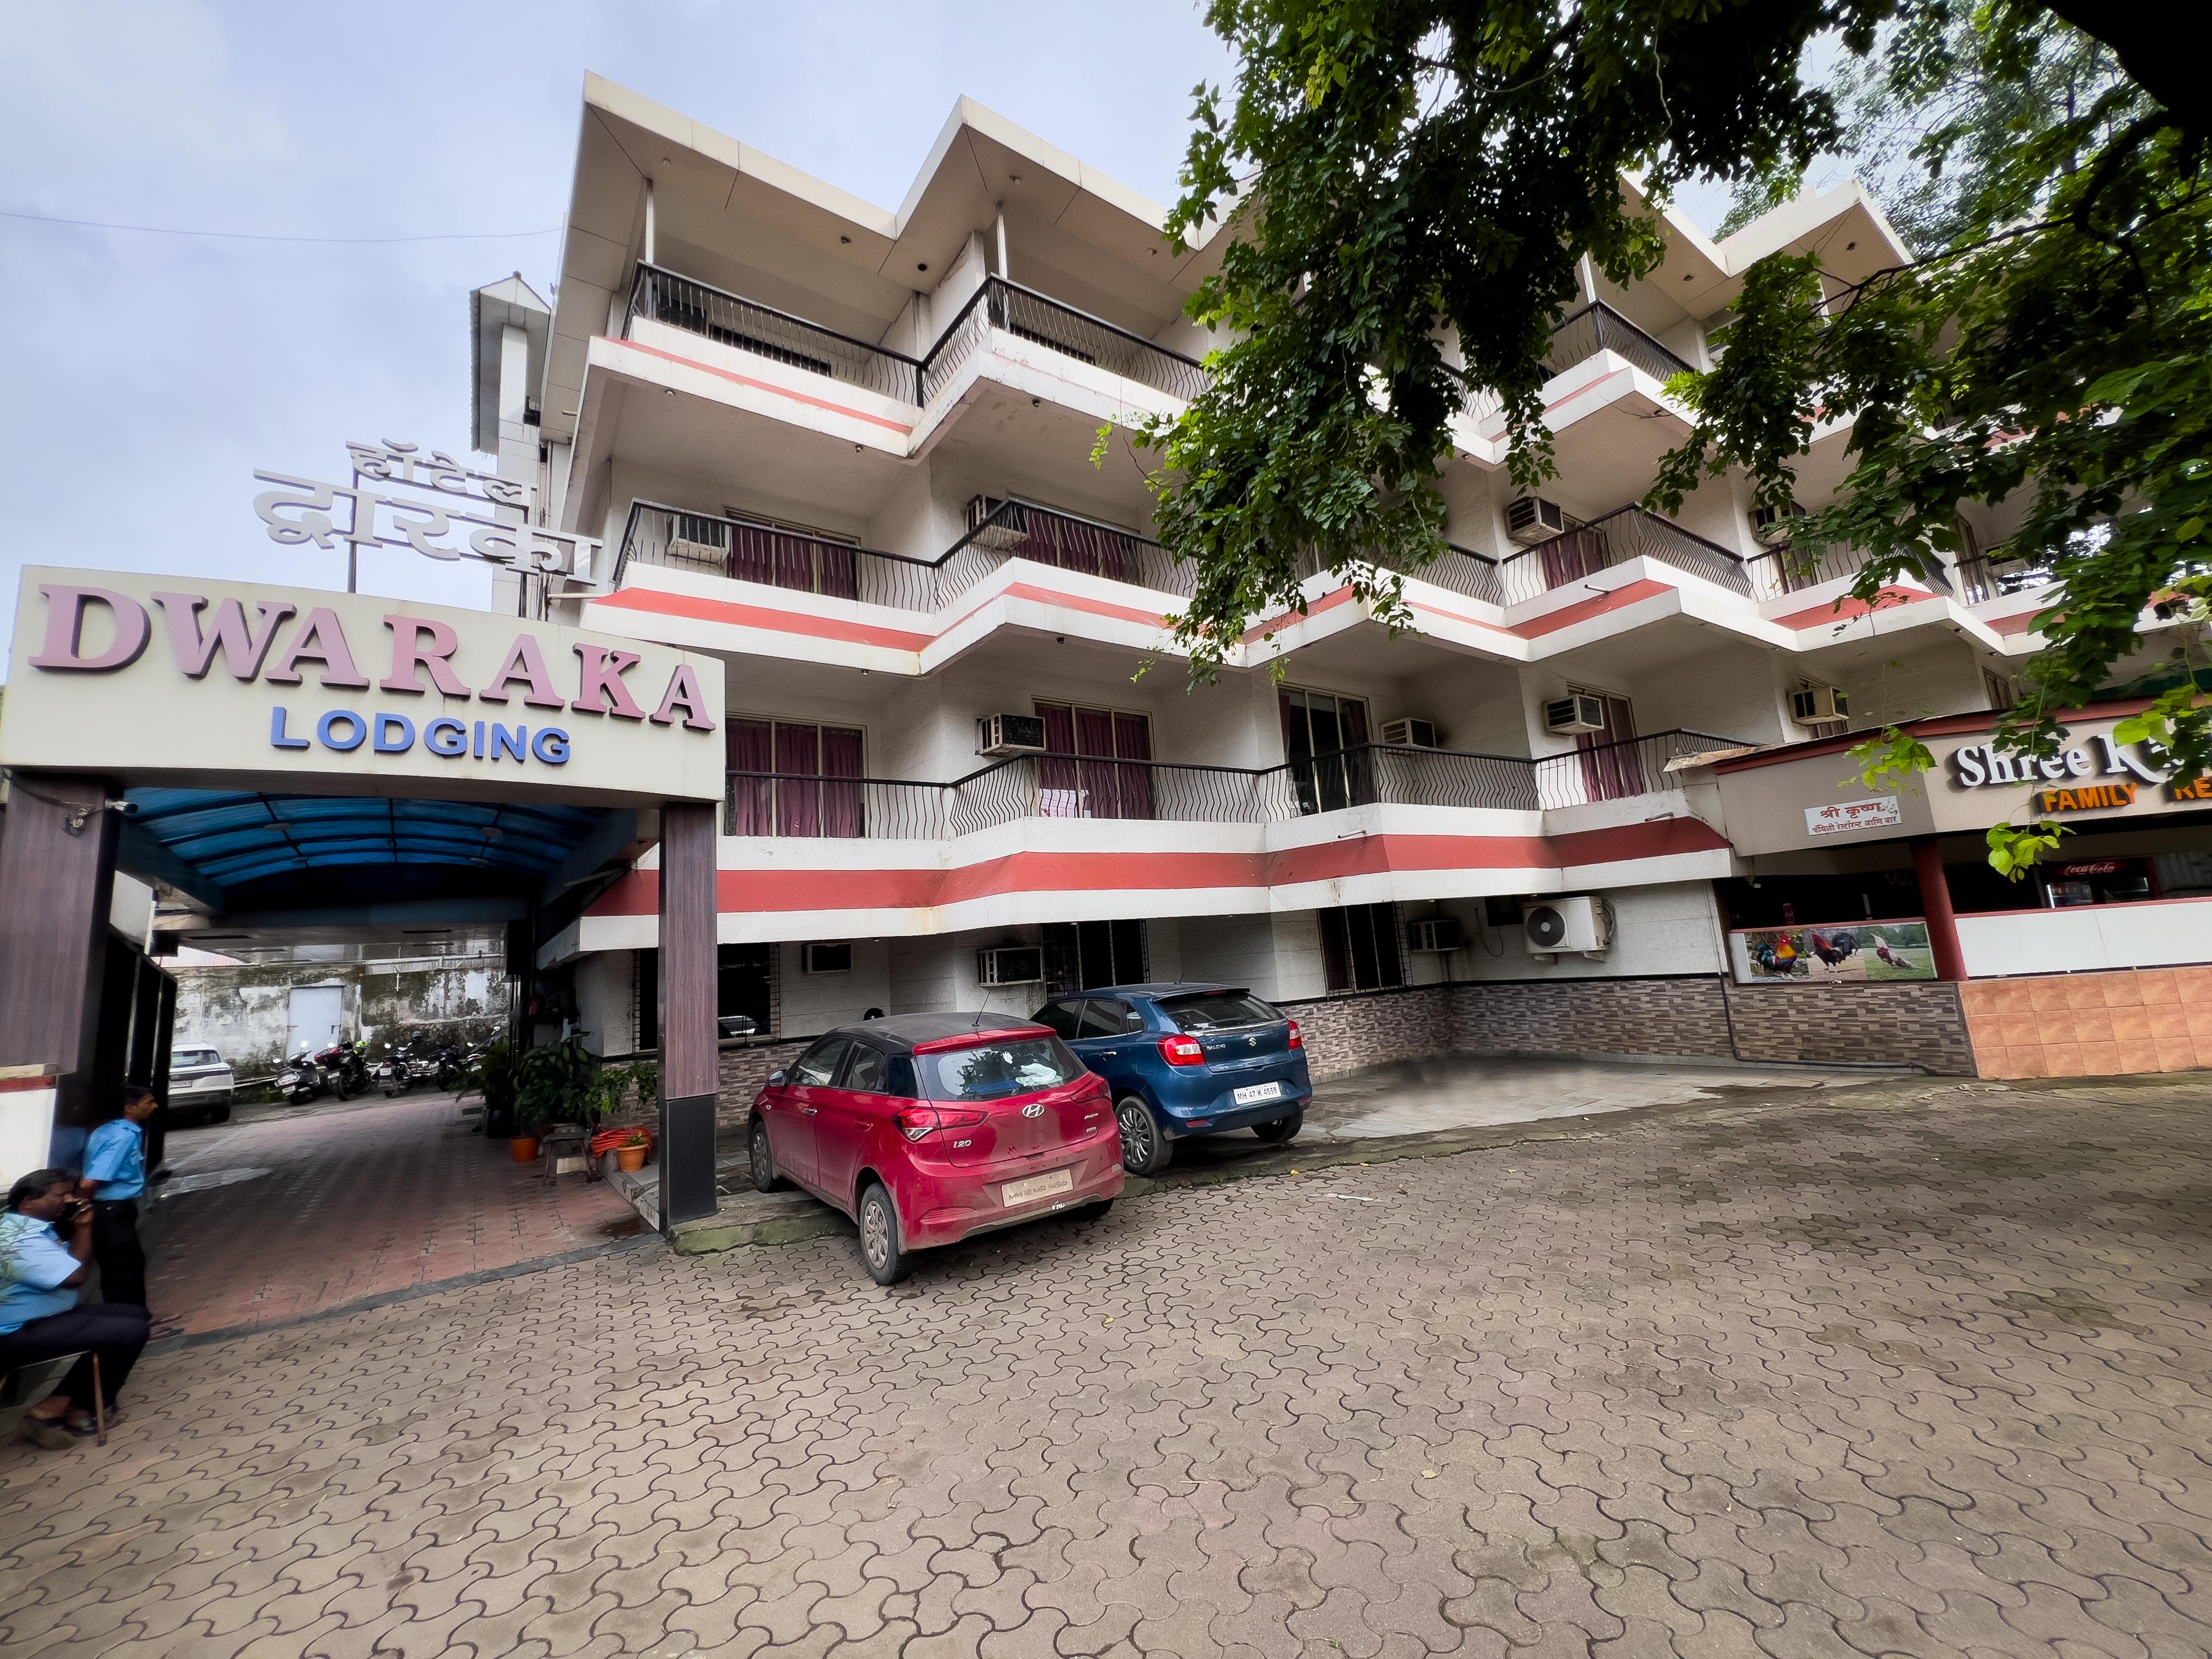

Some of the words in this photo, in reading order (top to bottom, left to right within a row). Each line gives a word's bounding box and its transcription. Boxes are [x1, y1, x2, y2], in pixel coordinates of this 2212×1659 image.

[346, 438, 537, 509] हॉटेल
[253, 468, 603, 587] द्वारका
[28, 584, 715, 731] DWARAKA
[270, 706, 571, 765] LODGING
[1957, 742, 2092, 787] Shree
[1820, 806, 1840, 819] श्री
[1844, 802, 1882, 819] कृष्ण
[2042, 782, 2138, 812] FAMILY
[1237, 1092, 1248, 1101] MH
[1008, 1192, 1023, 1200] MH
[1033, 1185, 1047, 1194] MR
[1048, 1180, 1068, 1190] 1456
